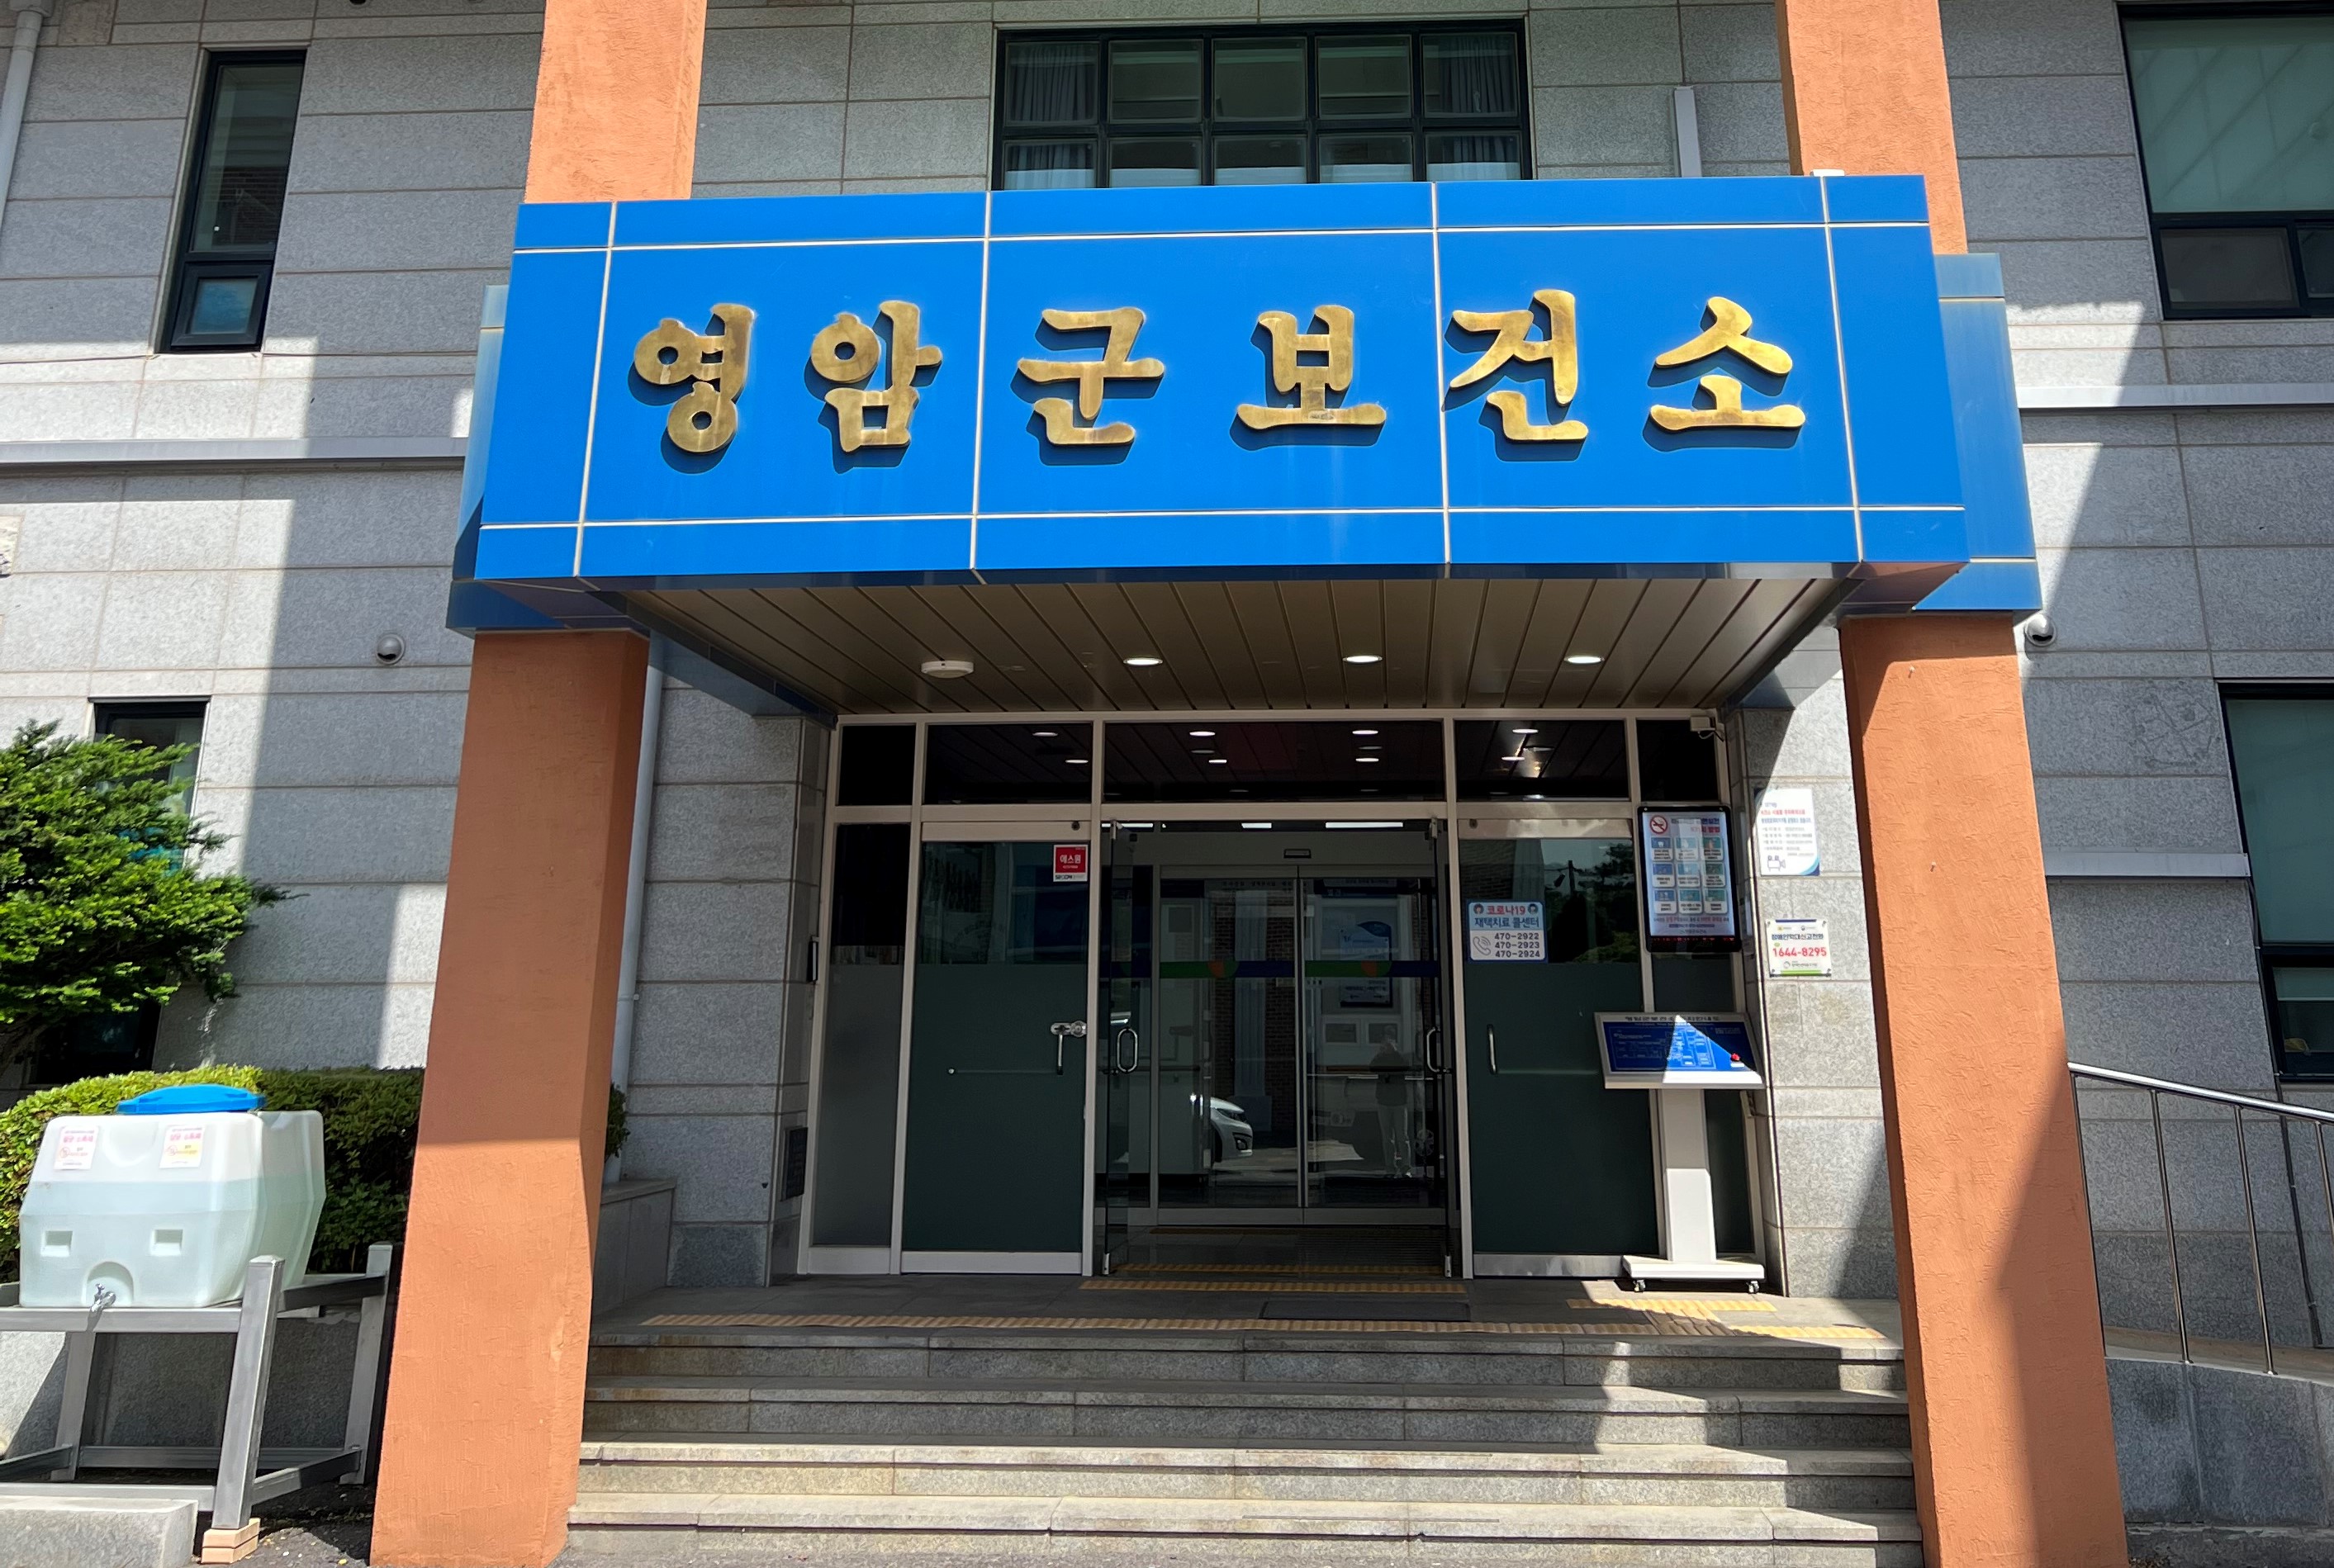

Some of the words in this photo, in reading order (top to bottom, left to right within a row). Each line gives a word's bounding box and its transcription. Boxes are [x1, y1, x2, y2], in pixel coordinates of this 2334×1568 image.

[1487, 905, 1526, 916] 코로나19
[1474, 917, 1511, 928] 재택치료
[1512, 917, 1540, 928] 콜센터
[1494, 932, 1539, 940] 470-2922
[1772, 947, 1827, 957] 1644-8295
